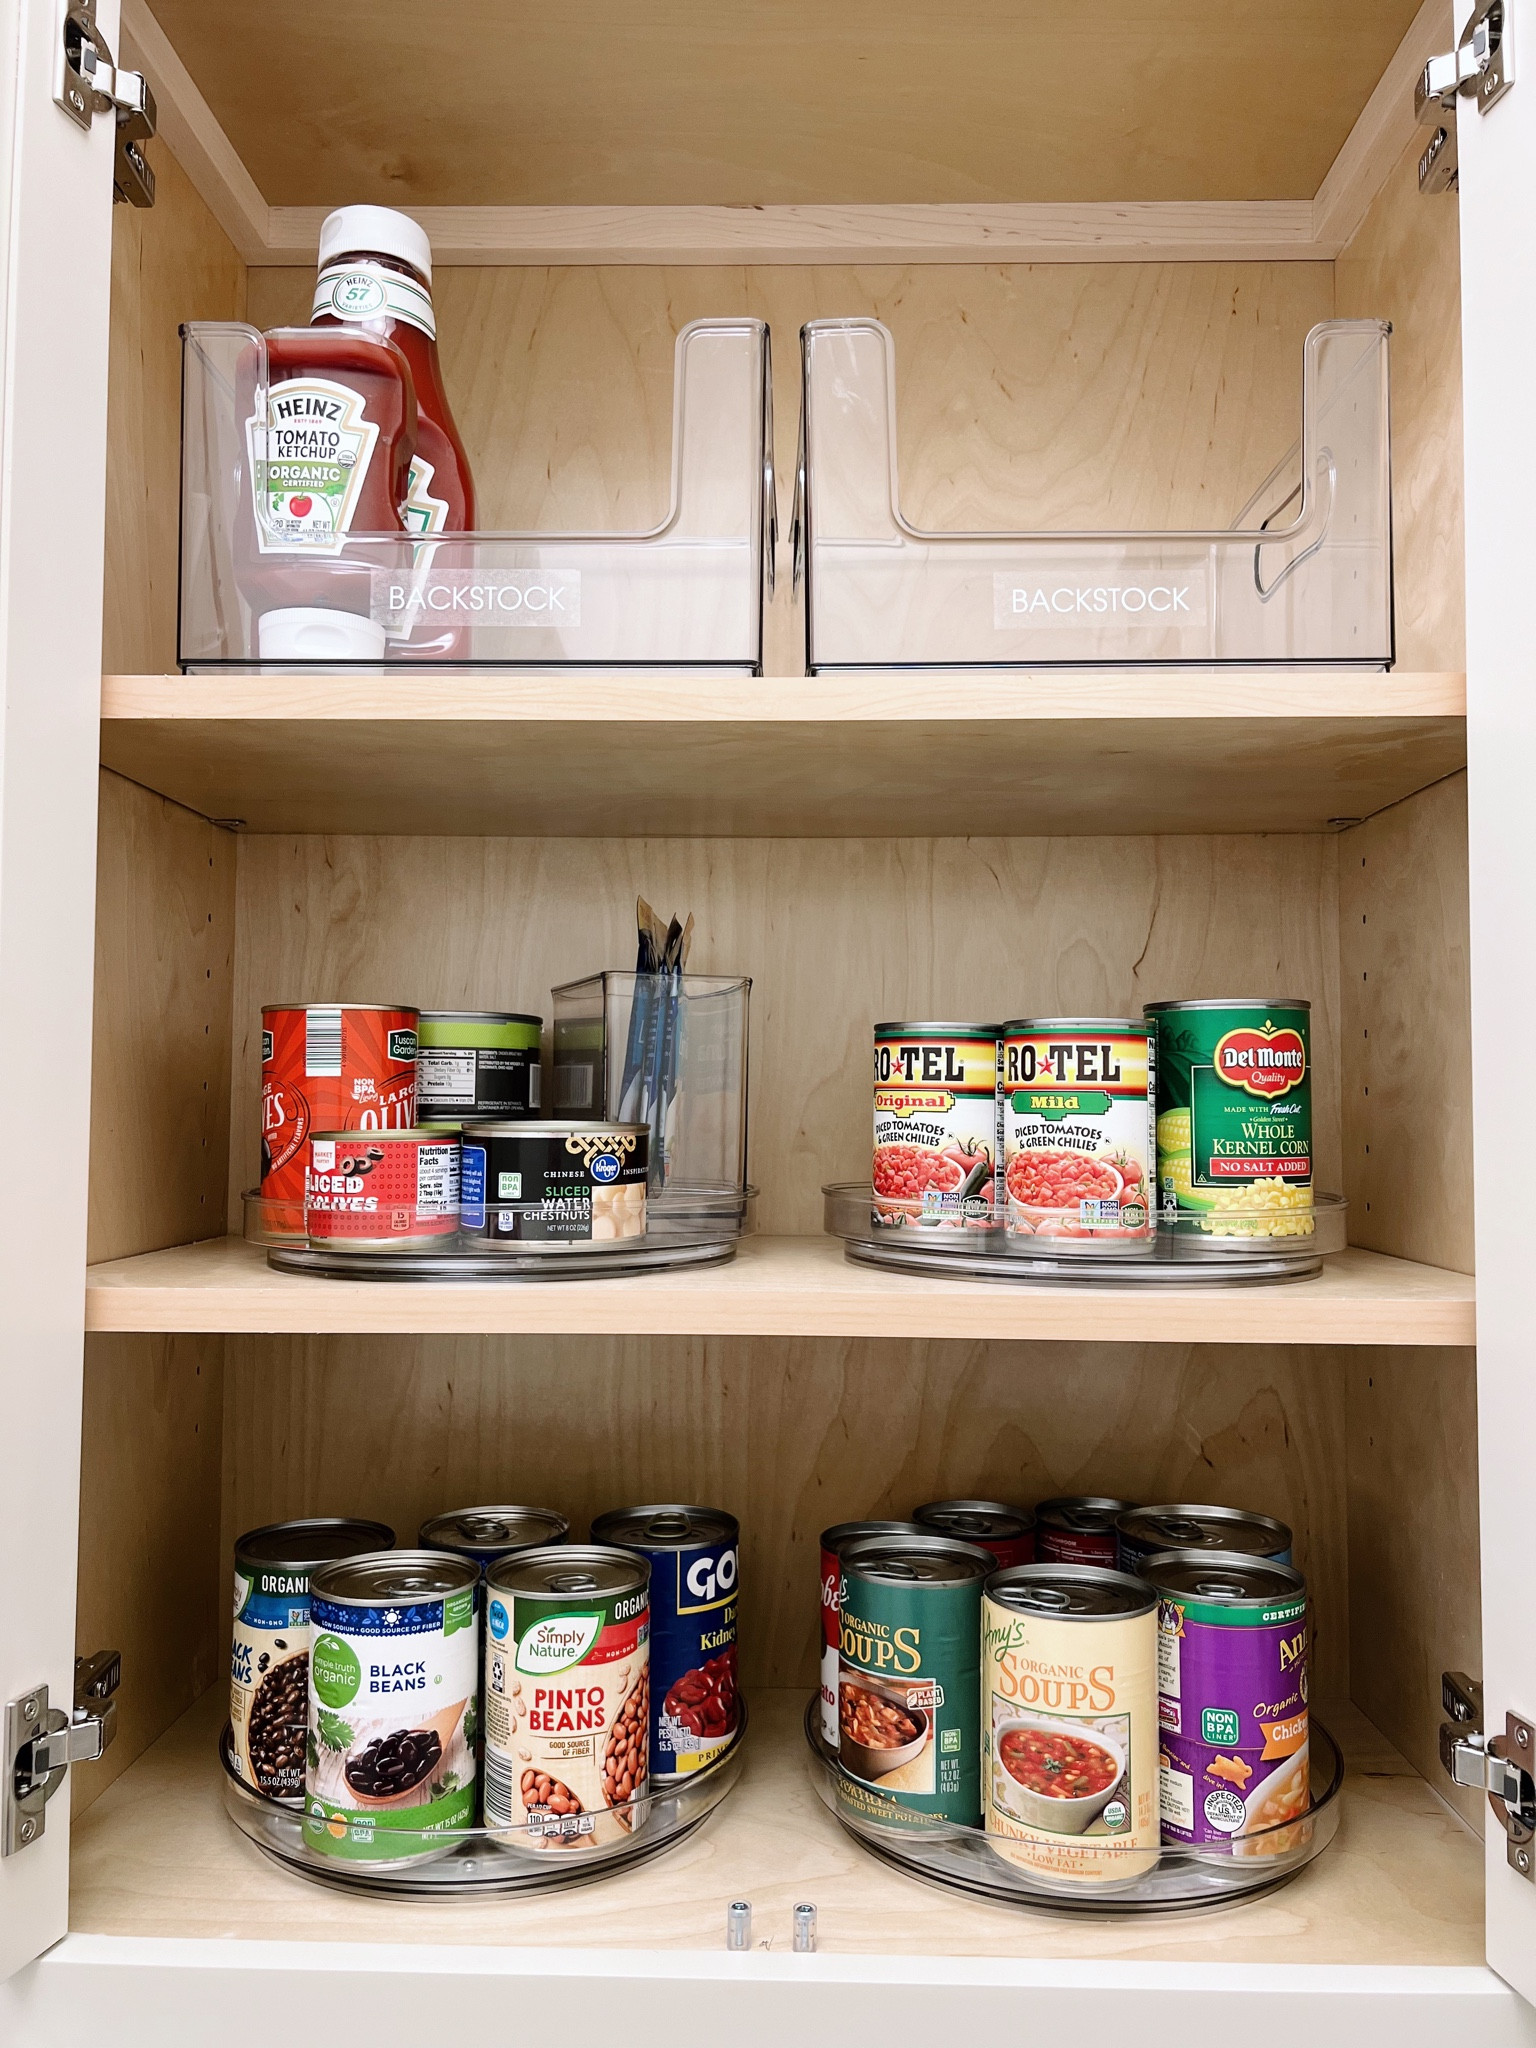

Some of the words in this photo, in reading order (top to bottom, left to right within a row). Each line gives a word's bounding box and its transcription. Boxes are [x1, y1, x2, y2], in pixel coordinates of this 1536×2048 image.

[346, 277, 373, 288] HEINZ
[346, 288, 370, 300] 57
[277, 398, 342, 421] HEINZ
[276, 430, 340, 446] TOMATO
[278, 446, 336, 459] KETCHUP
[270, 465, 340, 482] ORGANIC
[282, 480, 325, 488] CERTIFIED
[389, 585, 566, 611] BACKSTOCK
[1012, 587, 1190, 613] BACKSTOCK
[1224, 1048, 1255, 1068] Del
[1257, 1048, 1302, 1068] Monte
[354, 1078, 375, 1086] NON
[1251, 1071, 1286, 1085] Quality
[354, 1085, 376, 1094] BPA
[876, 1095, 946, 1110] Original
[1030, 1096, 1080, 1110] Mild
[360, 1097, 418, 1130] OLIV
[294, 1118, 304, 1142] FLAVORS
[892, 1120, 945, 1136] TOMATOES
[1015, 1125, 1038, 1138] DICED
[1040, 1124, 1102, 1140] TOMATOES
[1242, 1123, 1295, 1139] WHOLE
[882, 1132, 904, 1142] GREEN
[905, 1134, 940, 1146] CHILIES
[1020, 1140, 1025, 1150] &
[1026, 1136, 1055, 1148] GREEN
[1058, 1137, 1098, 1152] CHILIES
[419, 1146, 449, 1156] Nutrition
[1213, 1139, 1276, 1155] KERNEL
[1280, 1140, 1309, 1155] CORN
[419, 1157, 439, 1166] Facts
[596, 1160, 617, 1177] Kroger
[1220, 1162, 1240, 1172] NO
[1243, 1162, 1274, 1172] SALT
[1276, 1162, 1307, 1171] ADDED
[502, 1182, 519, 1190] BPA
[546, 1186, 590, 1197] SLICED
[541, 1198, 590, 1211] WATER
[523, 1211, 590, 1220] CHESTNUTS
[686, 1545, 738, 1600] GO
[262, 1575, 310, 1594] ORGANI
[254, 1618, 283, 1626] NON-GMO
[322, 1620, 332, 1628] LOW
[333, 1622, 354, 1632] SODIUM
[382, 1626, 410, 1634] SOURCE
[422, 1621, 441, 1630] FIBER
[845, 1612, 890, 1638] ORGANIC
[538, 1630, 585, 1646] Simply
[985, 1612, 1025, 1662] Amy's
[606, 1644, 634, 1658] NON-GMO
[314, 1656, 334, 1670] simple
[335, 1662, 356, 1673] truth
[370, 1661, 426, 1677] BLACK
[1020, 1658, 1084, 1679] ORGANIC
[314, 1668, 356, 1686] organic
[1000, 1652, 1115, 1712] SOUPS
[370, 1677, 426, 1693] BEANS
[535, 1686, 604, 1709] PINTO
[917, 1688, 940, 1699] PLANT
[1253, 1692, 1298, 1718] Organic
[530, 1707, 605, 1732] BEANS
[1206, 1712, 1233, 1723] NON
[1206, 1723, 1234, 1734] BPA
[549, 1741, 566, 1749] GOOD
[567, 1739, 590, 1747] SOURCE
[572, 1747, 590, 1755] FIBER
[659, 1741, 672, 1752] 15.5
[941, 1760, 950, 1770] NET
[278, 1769, 290, 1777] NET
[291, 1768, 300, 1777] WT
[941, 1772, 951, 1781] 14.2
[260, 1776, 271, 1784] 15.5
[1202, 1775, 1215, 1785] dive
[941, 1782, 960, 1794] (403g)
[1207, 1792, 1243, 1810] INSPECTED
[866, 1804, 892, 1819] SWEET
[445, 1818, 451, 1827] 15
[451, 1814, 457, 1824] OZ
[1032, 1854, 1055, 1865] LOW
[1058, 1859, 1078, 1868] FAT
